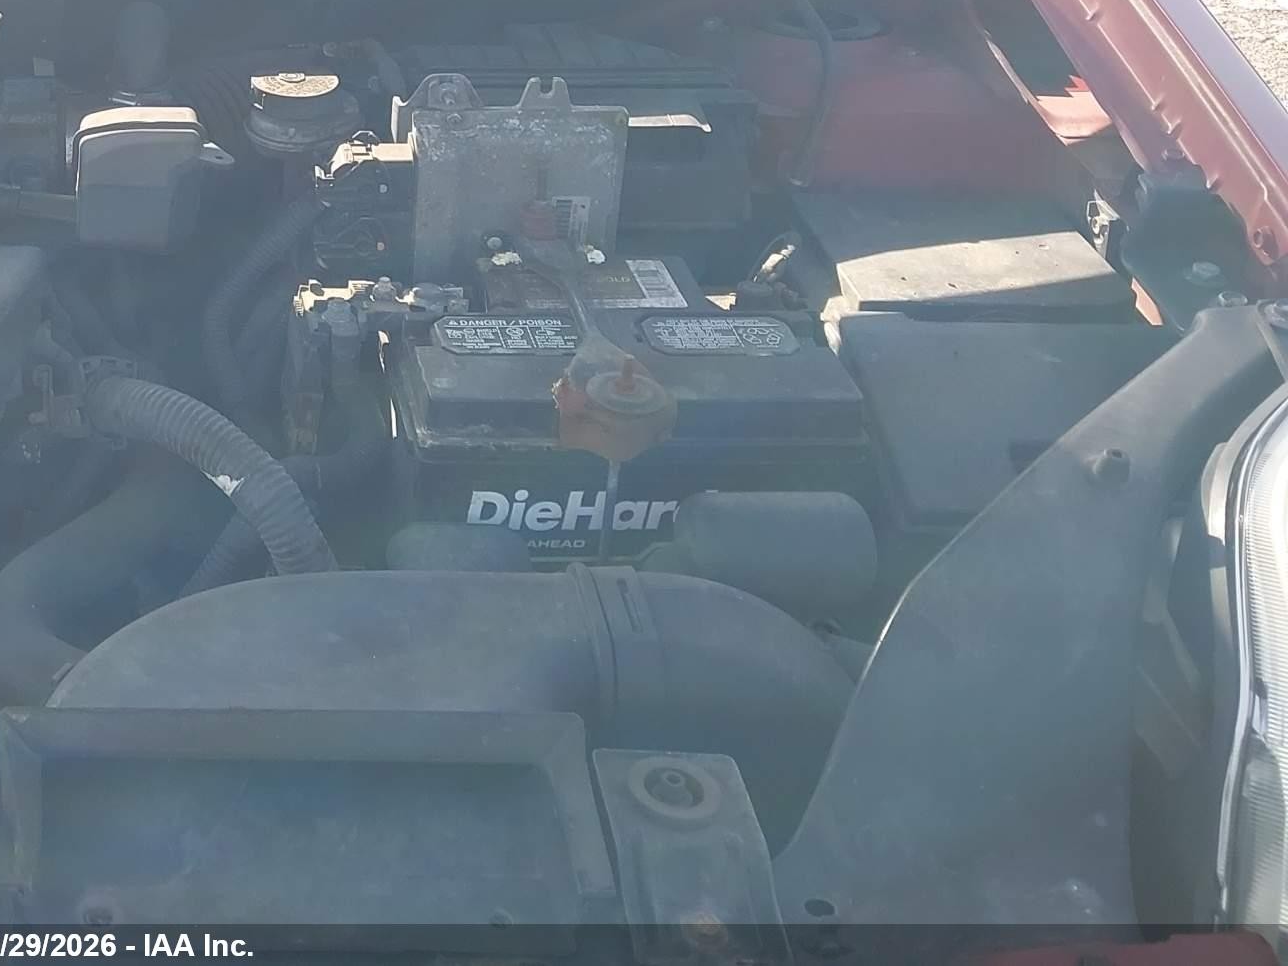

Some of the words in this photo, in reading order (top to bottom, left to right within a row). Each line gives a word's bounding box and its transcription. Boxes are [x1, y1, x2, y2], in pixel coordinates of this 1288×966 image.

[459, 319, 507, 327] DANGER
[519, 319, 562, 327] POISON
[527, 539, 586, 549] AHEAD
